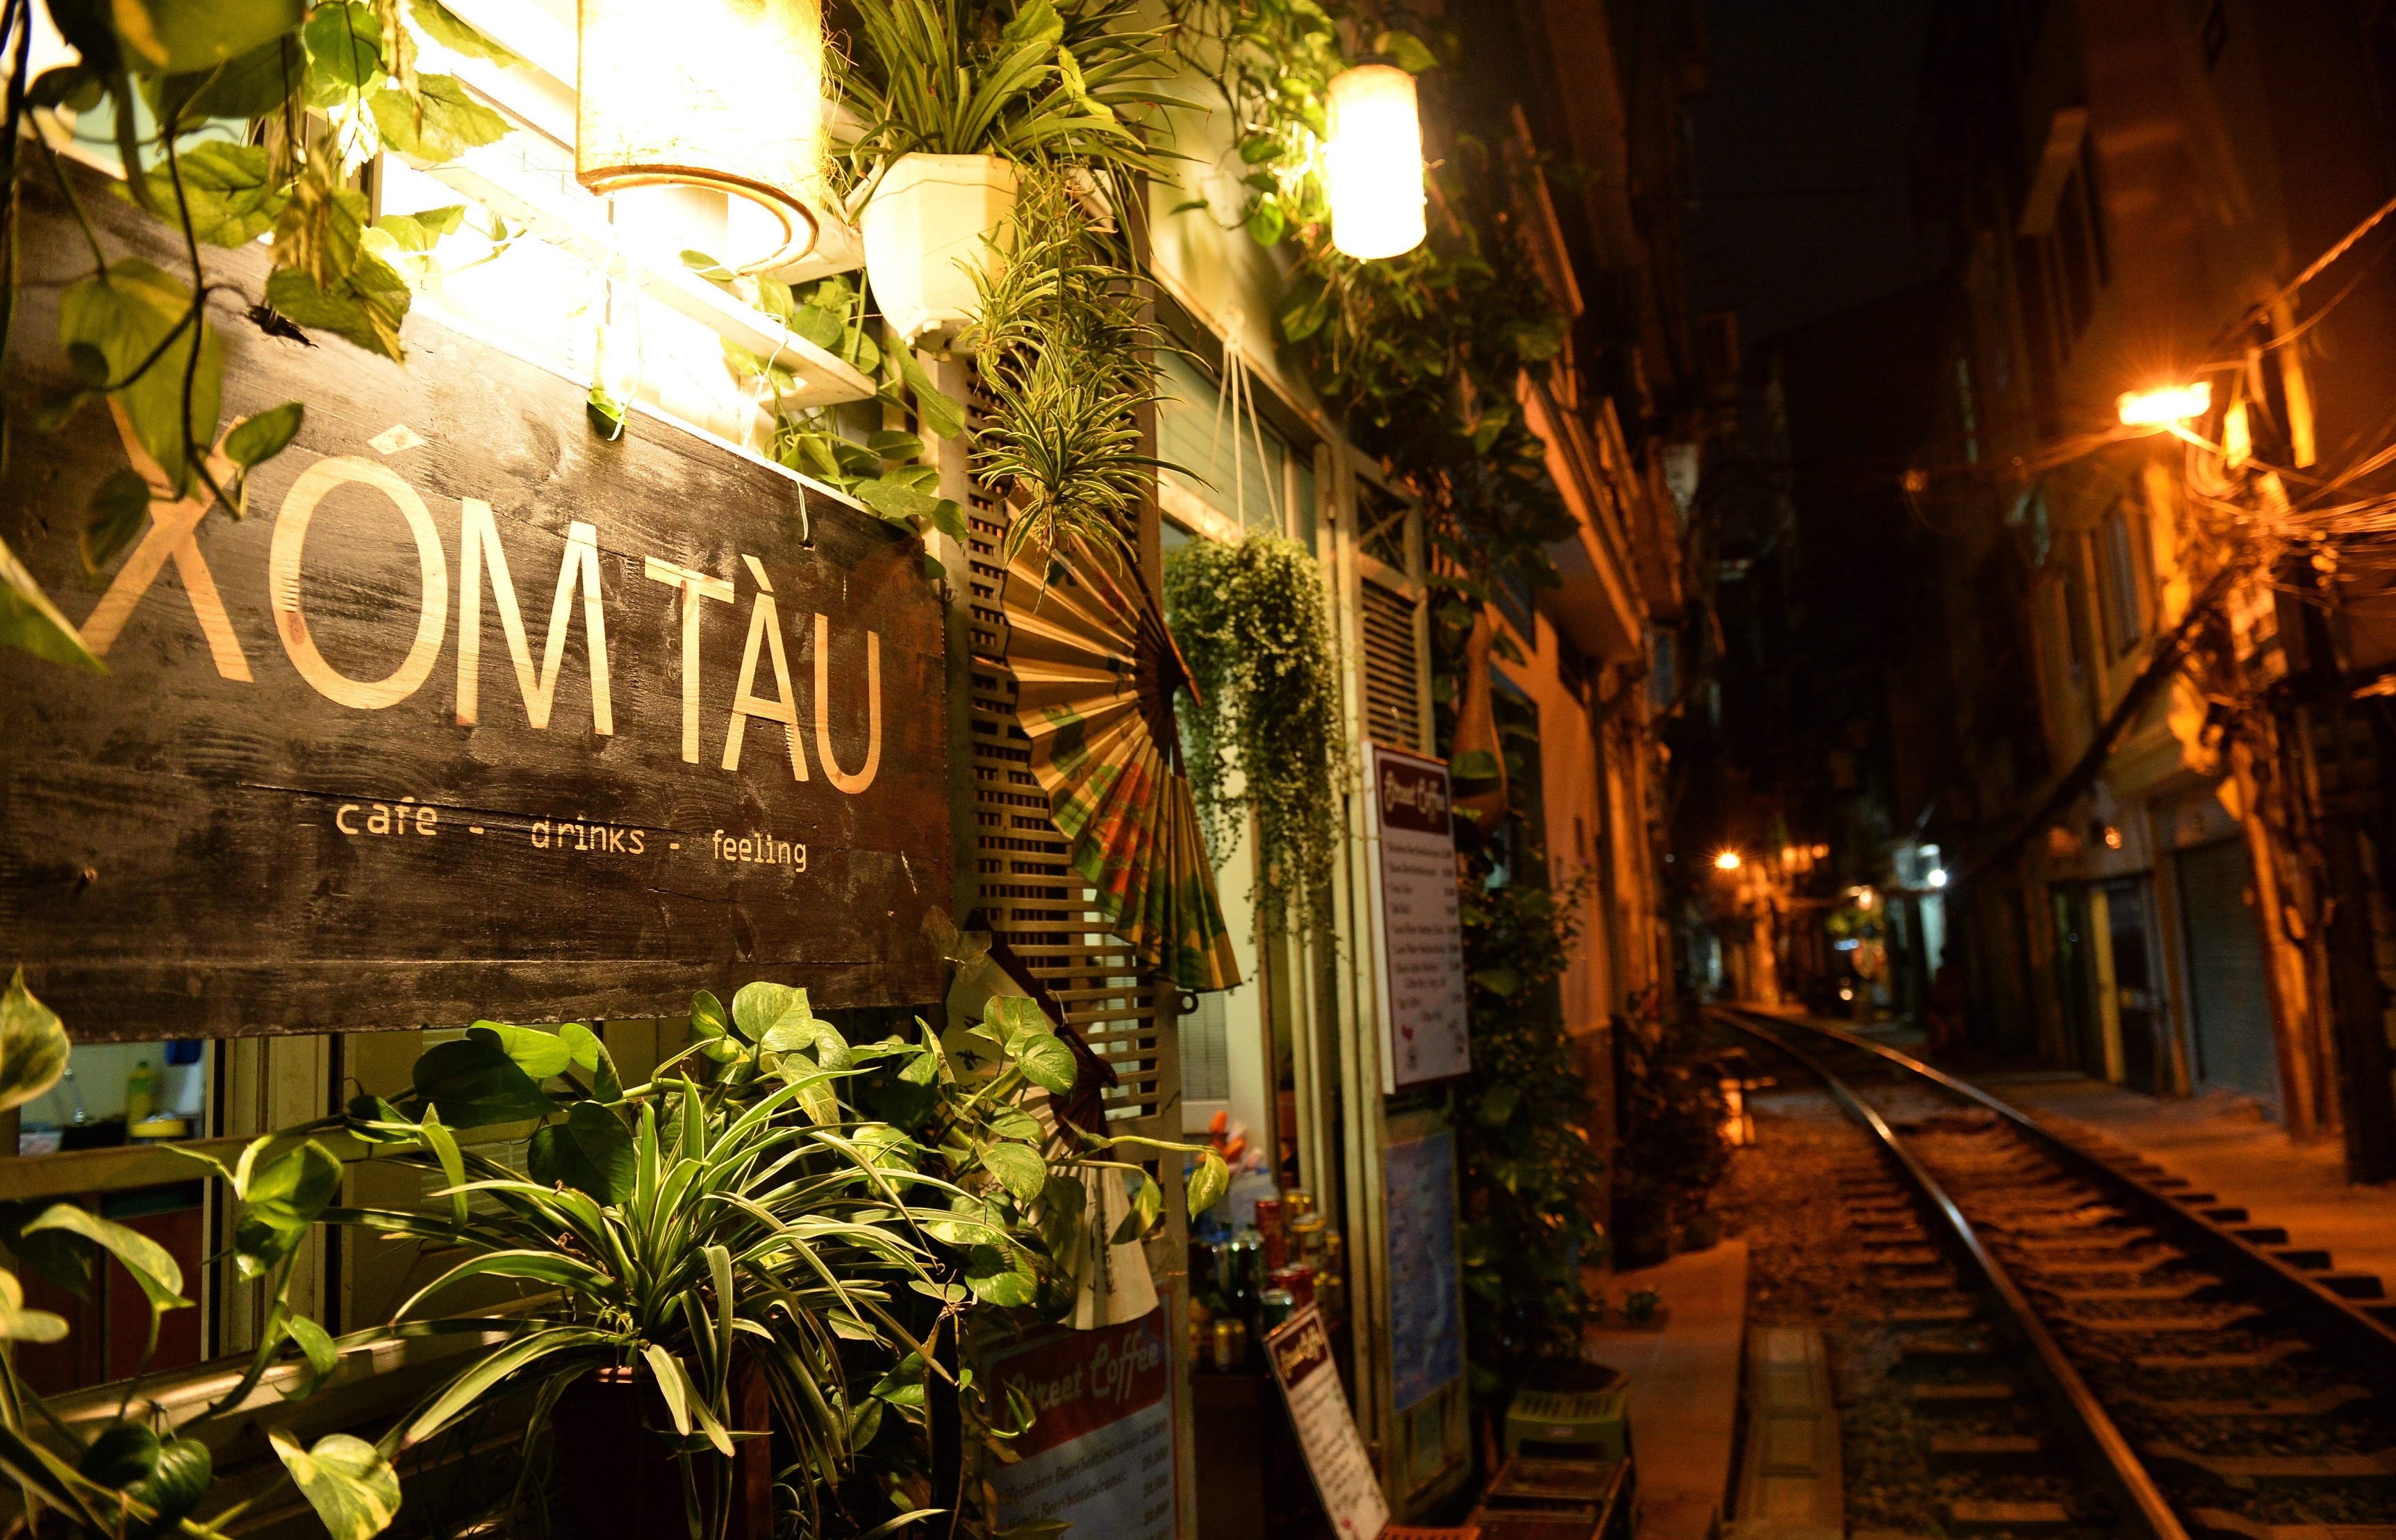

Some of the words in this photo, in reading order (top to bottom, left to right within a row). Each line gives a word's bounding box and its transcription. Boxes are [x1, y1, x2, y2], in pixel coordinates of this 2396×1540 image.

[77, 393, 613, 736] XÓM
[645, 554, 882, 795] TÀU
[531, 813, 645, 854] drinks
[712, 829, 807, 872] feeling
[1089, 1330, 1159, 1405] Coffee
